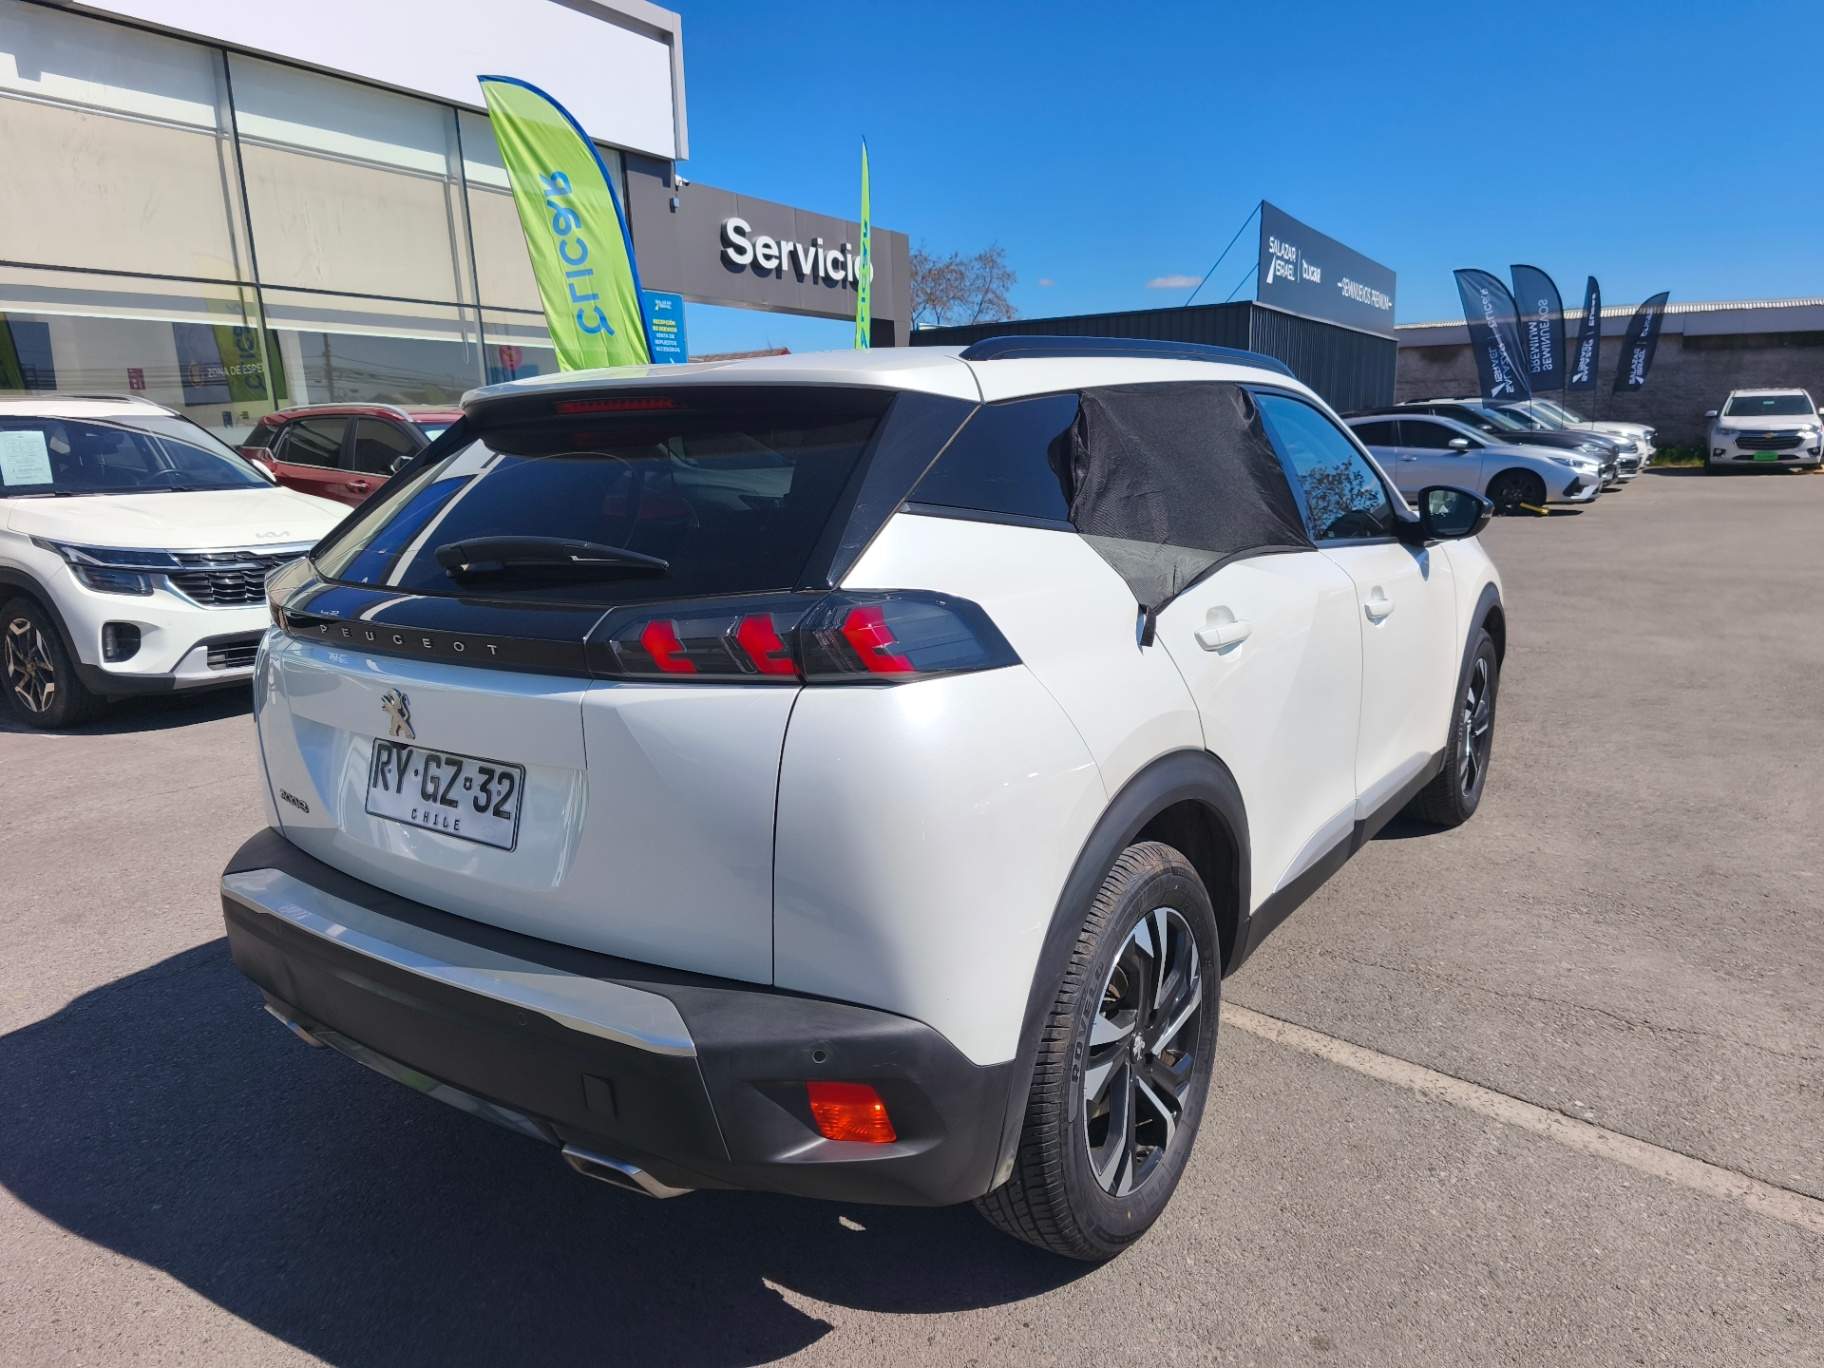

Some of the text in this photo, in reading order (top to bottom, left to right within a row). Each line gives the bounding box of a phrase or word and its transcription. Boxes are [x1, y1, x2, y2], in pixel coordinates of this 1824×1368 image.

[1268, 236, 1297, 263] SALAZAR
[1274, 260, 1296, 281] ISRAEL
[230, 365, 242, 376] DE
[242, 363, 265, 375] ESPE
[319, 624, 498, 656] PEUGEOT
[410, 808, 462, 831] CHILE
